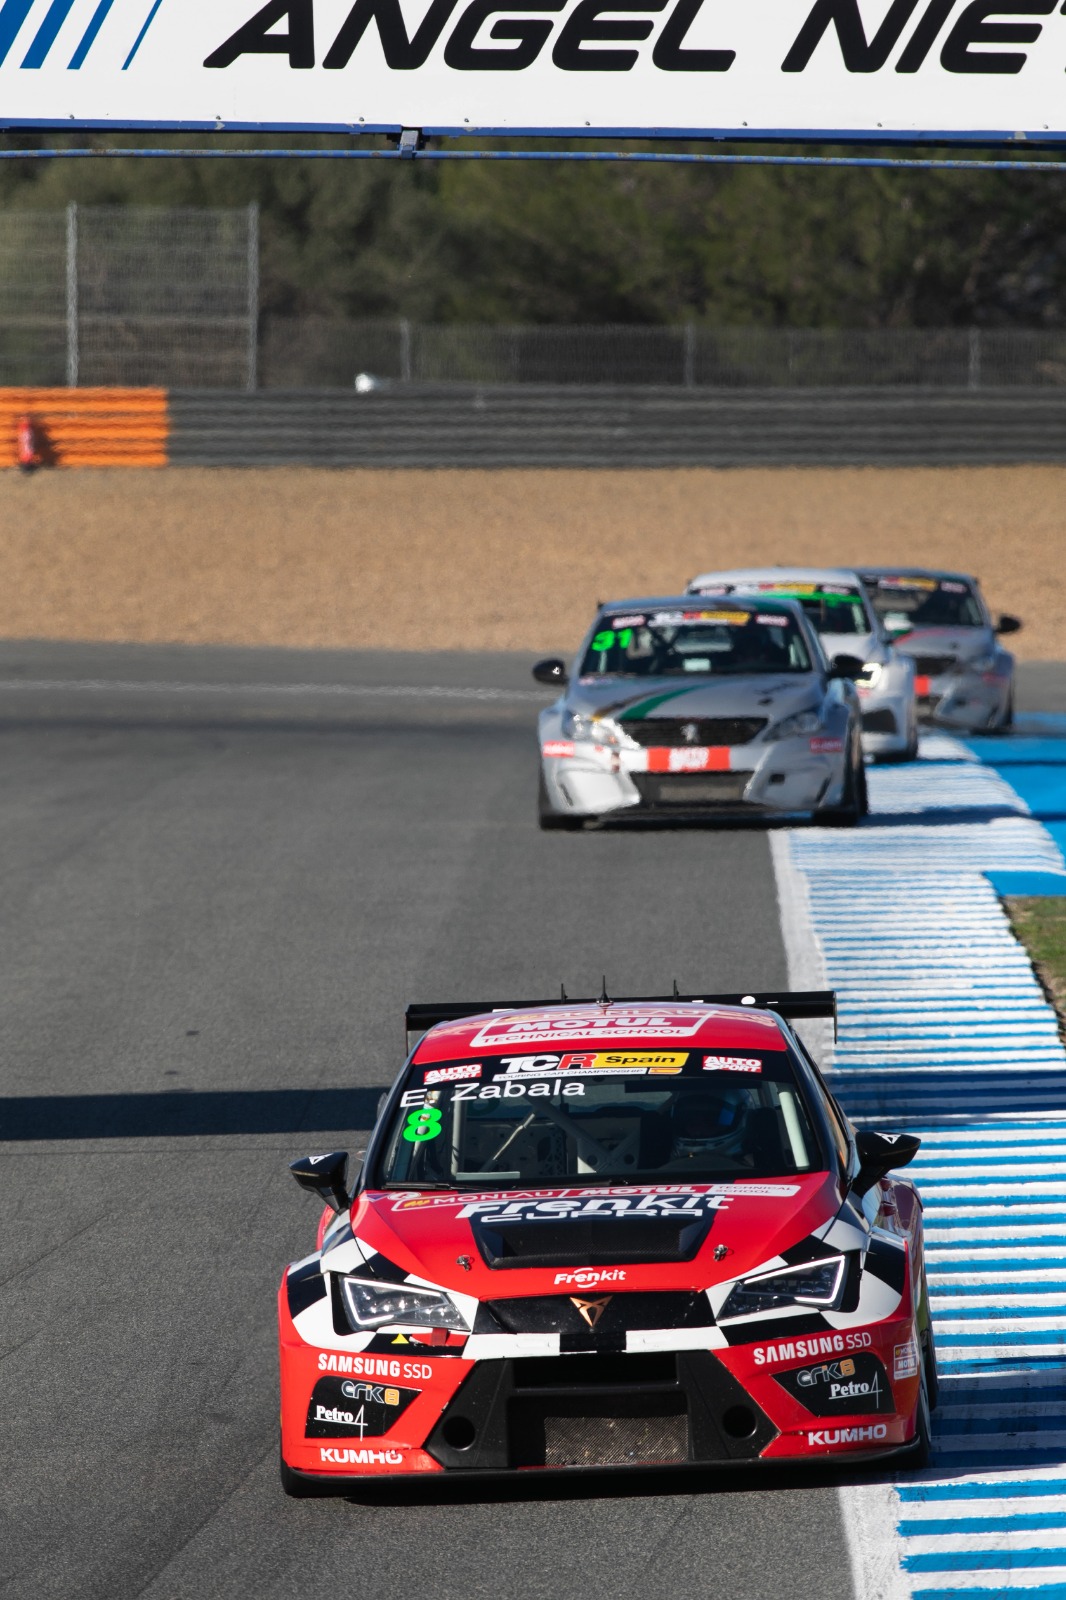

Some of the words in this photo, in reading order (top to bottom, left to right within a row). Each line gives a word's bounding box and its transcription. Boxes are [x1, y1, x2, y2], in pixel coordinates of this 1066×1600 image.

[203, 0, 736, 72] ANGEL
[780, 0, 1066, 74] NIE
[507, 1017, 671, 1033] MOTUL
[483, 1030, 591, 1043] TECHNICAL
[601, 1028, 685, 1036] SCHOOL
[426, 1064, 481, 1078] AUTO
[500, 1053, 599, 1074] TCR
[605, 1056, 676, 1065] Spain
[703, 1056, 761, 1067] AUTO
[451, 1079, 586, 1102] Zabala
[403, 1108, 442, 1142] 8
[433, 1191, 553, 1205] MONLAU
[578, 1186, 696, 1196] MOTUL
[455, 1193, 734, 1218] Frenkit
[481, 1208, 703, 1222] CUPRA
[554, 1268, 627, 1287] Frenkit
[753, 1335, 844, 1365] SAMSUNG
[845, 1332, 872, 1349] SSD
[318, 1353, 400, 1377] SAMSUNG
[403, 1363, 432, 1379] SSD
[808, 1424, 887, 1446] KUMHO
[320, 1448, 403, 1464] KUMHO
